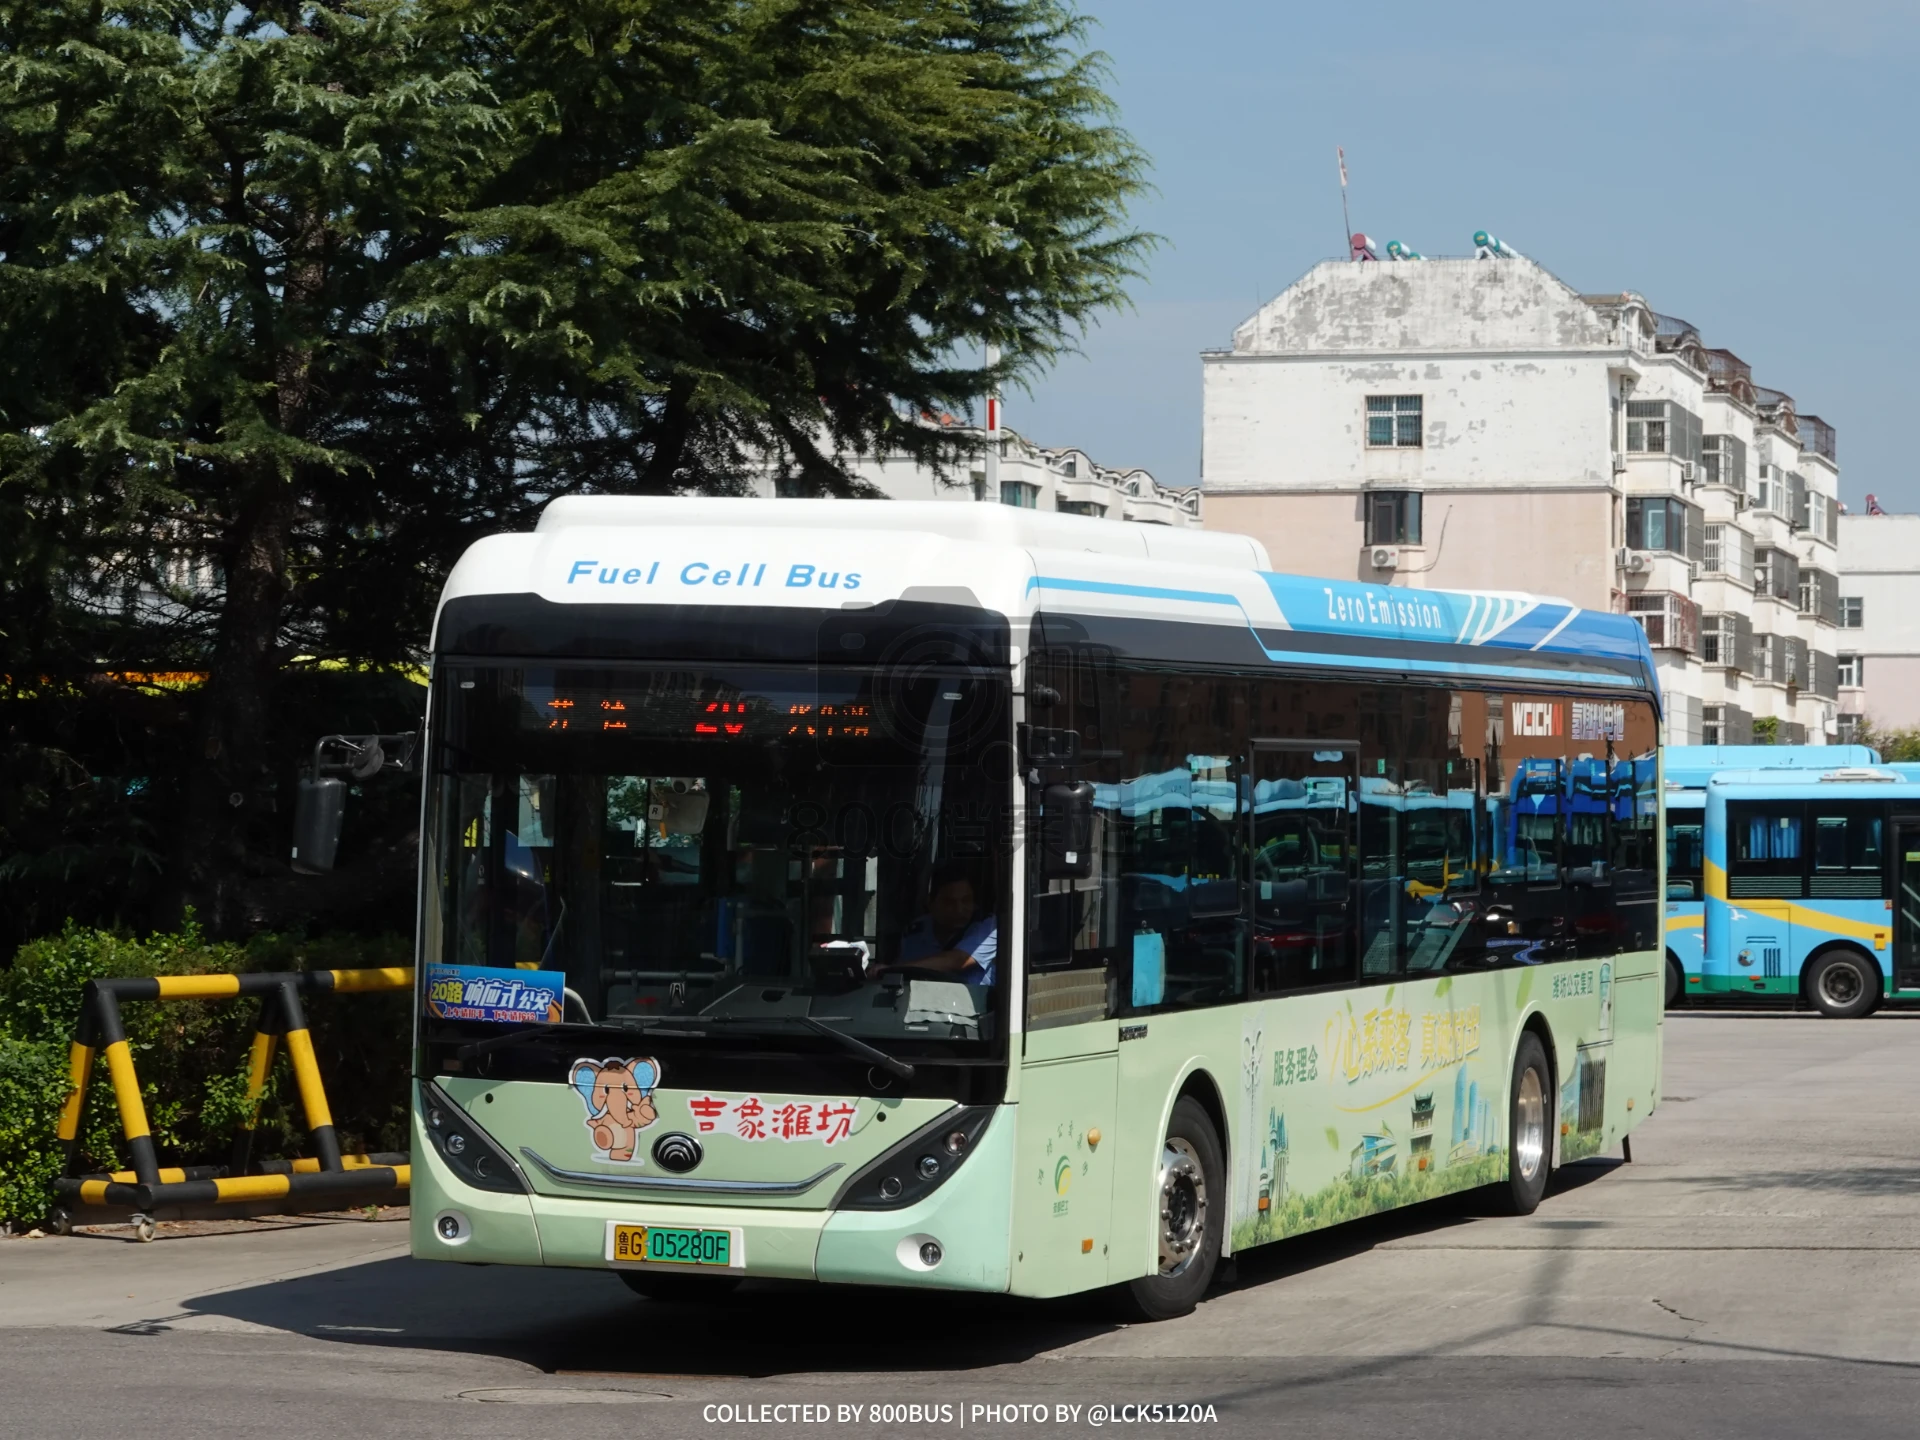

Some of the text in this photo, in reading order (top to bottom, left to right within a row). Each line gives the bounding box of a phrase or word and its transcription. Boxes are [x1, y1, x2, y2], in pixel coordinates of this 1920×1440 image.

[567, 560, 862, 590] Fuel Cell Bus
[1342, 1003, 1481, 1084] 心系乘客 真诚付出
[1273, 1044, 1319, 1087] 服务理念
[690, 1096, 856, 1145] 吉象潍坊
[652, 1233, 728, 1261] 05280F
